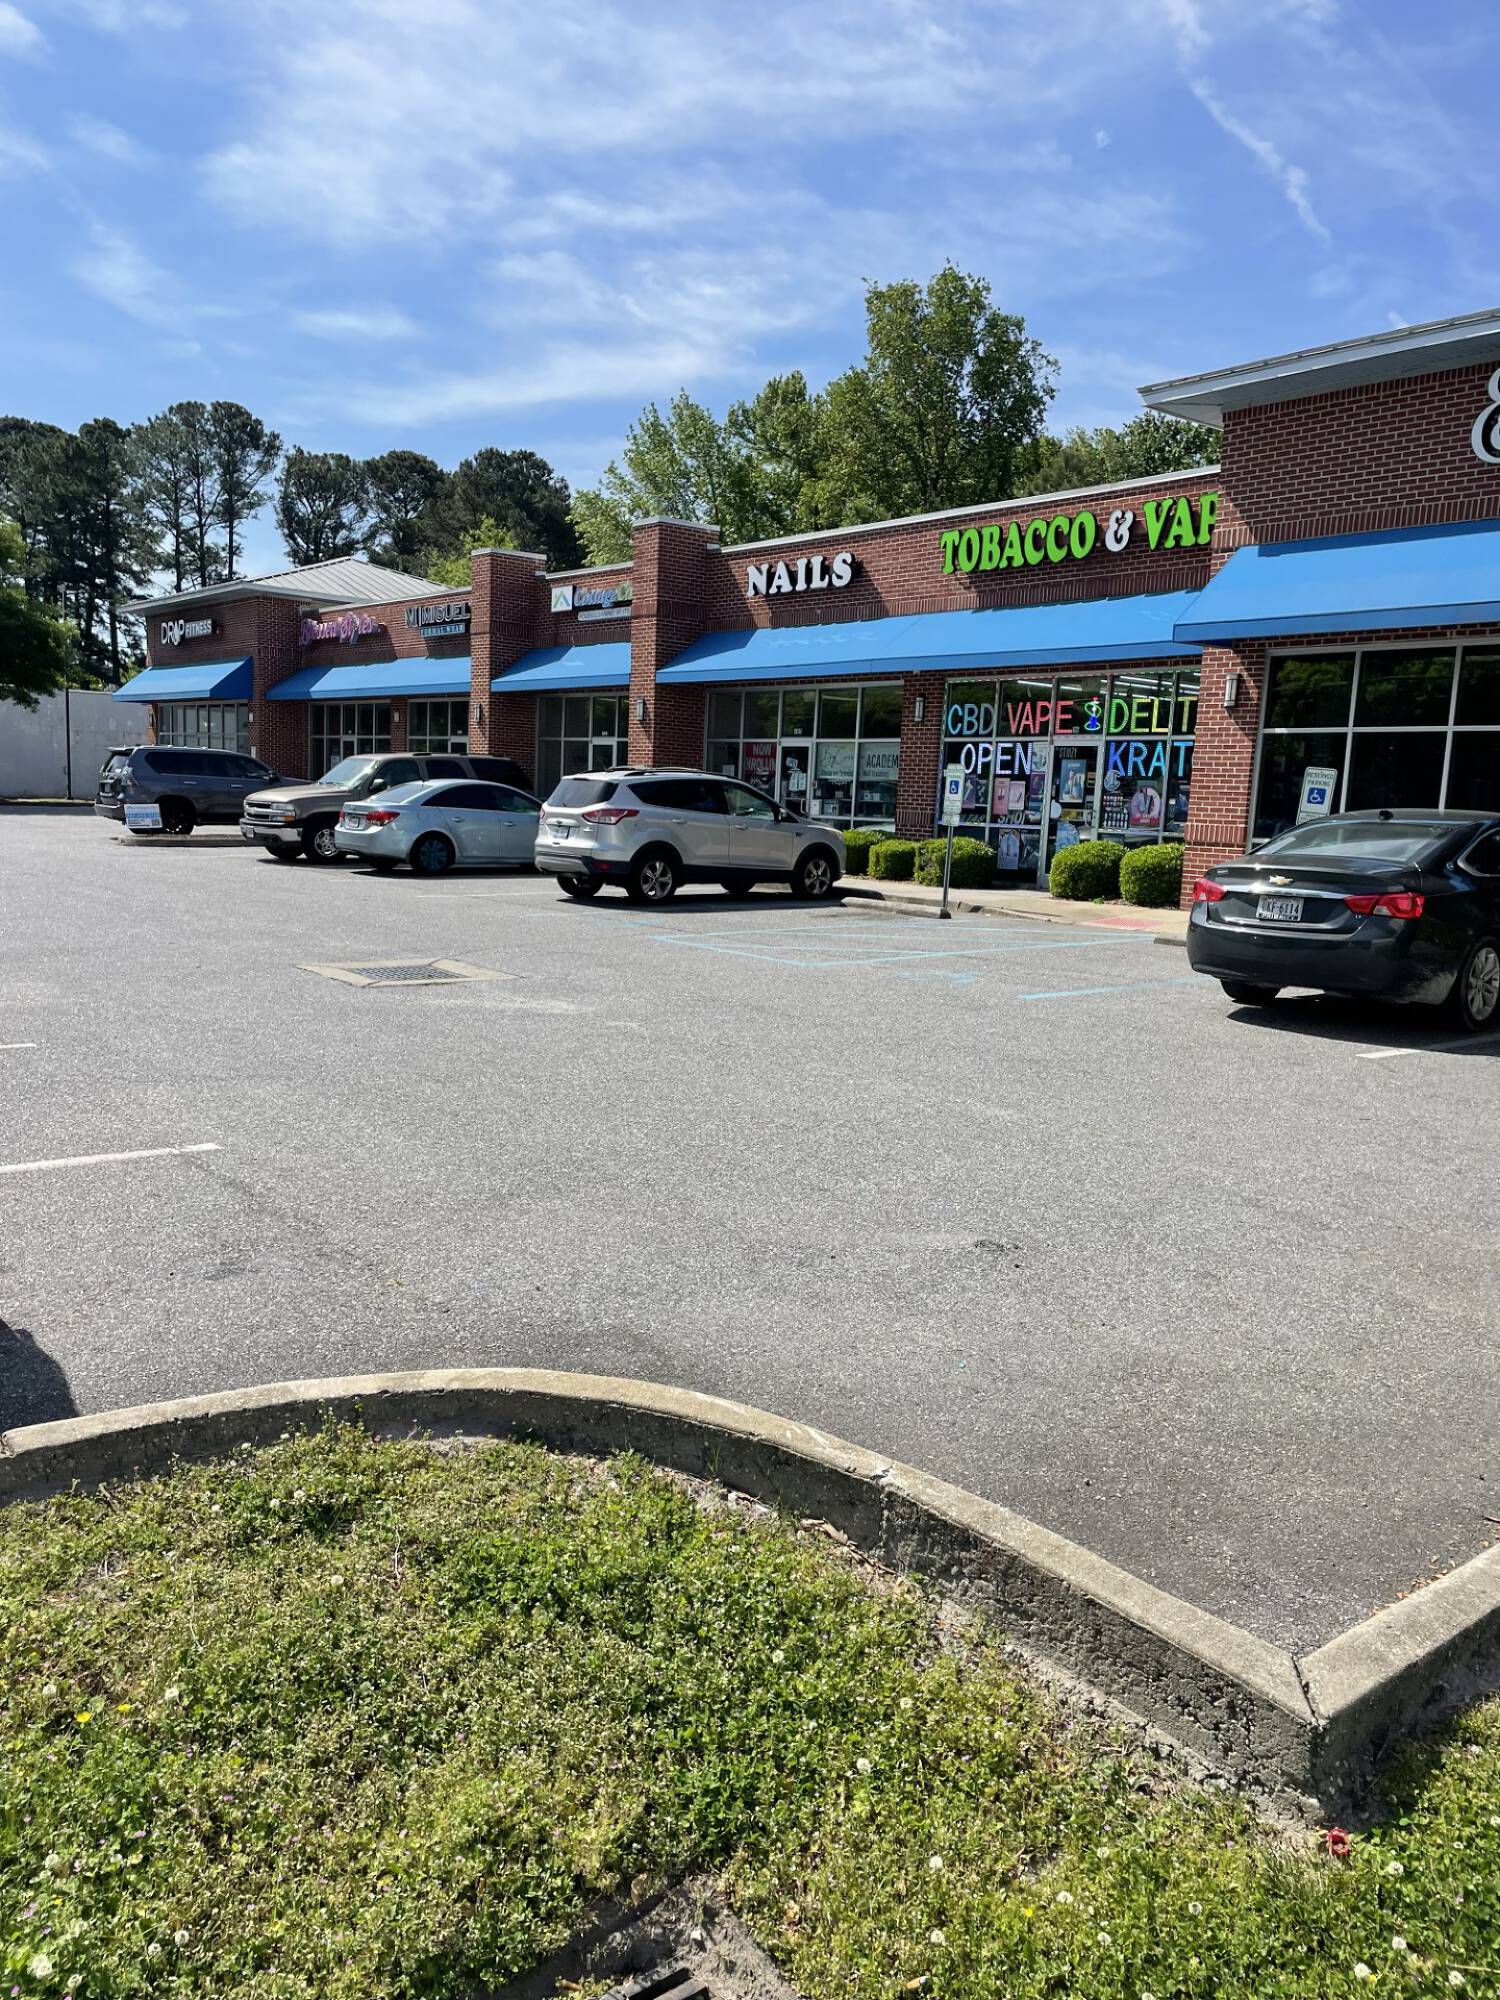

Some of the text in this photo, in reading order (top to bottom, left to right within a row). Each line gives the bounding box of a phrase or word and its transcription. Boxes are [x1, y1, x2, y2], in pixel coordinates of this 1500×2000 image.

[940, 510, 1096, 574] TOBACCO
[1105, 509, 1134, 552] &
[746, 551, 852, 597] NAILS
[186, 620, 212, 637] FITNESS
[947, 703, 995, 736] CBD
[1007, 700, 1074, 735] VAPE
[960, 742, 1033, 776] OPEN
